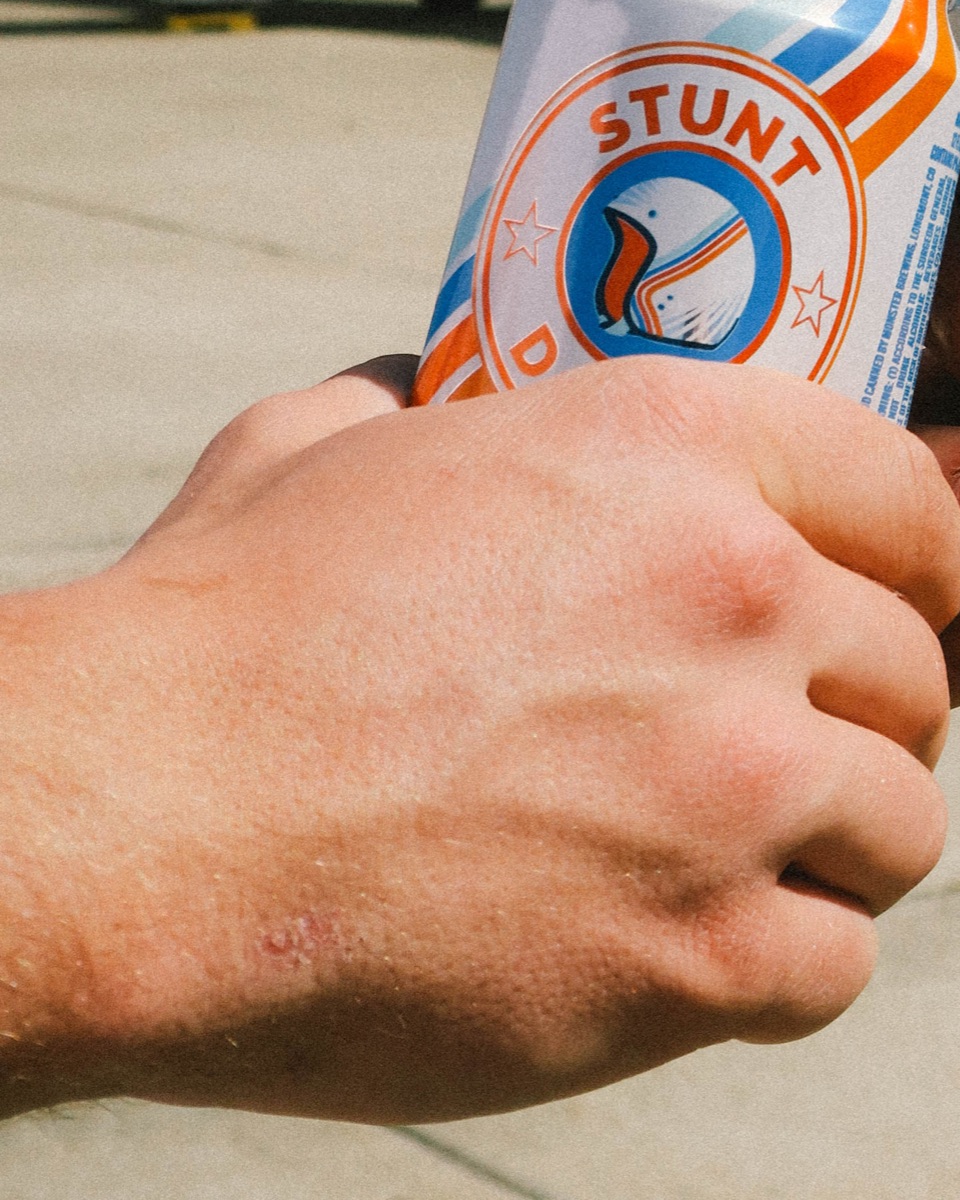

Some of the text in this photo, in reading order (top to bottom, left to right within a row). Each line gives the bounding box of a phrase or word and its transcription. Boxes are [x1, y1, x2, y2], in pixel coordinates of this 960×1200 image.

[589, 84, 822, 187] STUNT
[926, 166, 937, 182] CO
[910, 184, 933, 241] LONGMONT,
[916, 222, 936, 271] SURGEON
[906, 291, 919, 305] TO
[911, 270, 924, 291] THE
[881, 290, 903, 340] MONSTER
[877, 338, 888, 354] BY
[891, 307, 915, 364] ACCORDING
[864, 353, 884, 396] CANNED
[886, 366, 898, 380] (1)
[888, 399, 899, 419] NOT
[896, 356, 911, 389] DRINK
[906, 292, 926, 349] ALCOHOLIC
[861, 396, 872, 408] D
[877, 381, 895, 417] NING:
